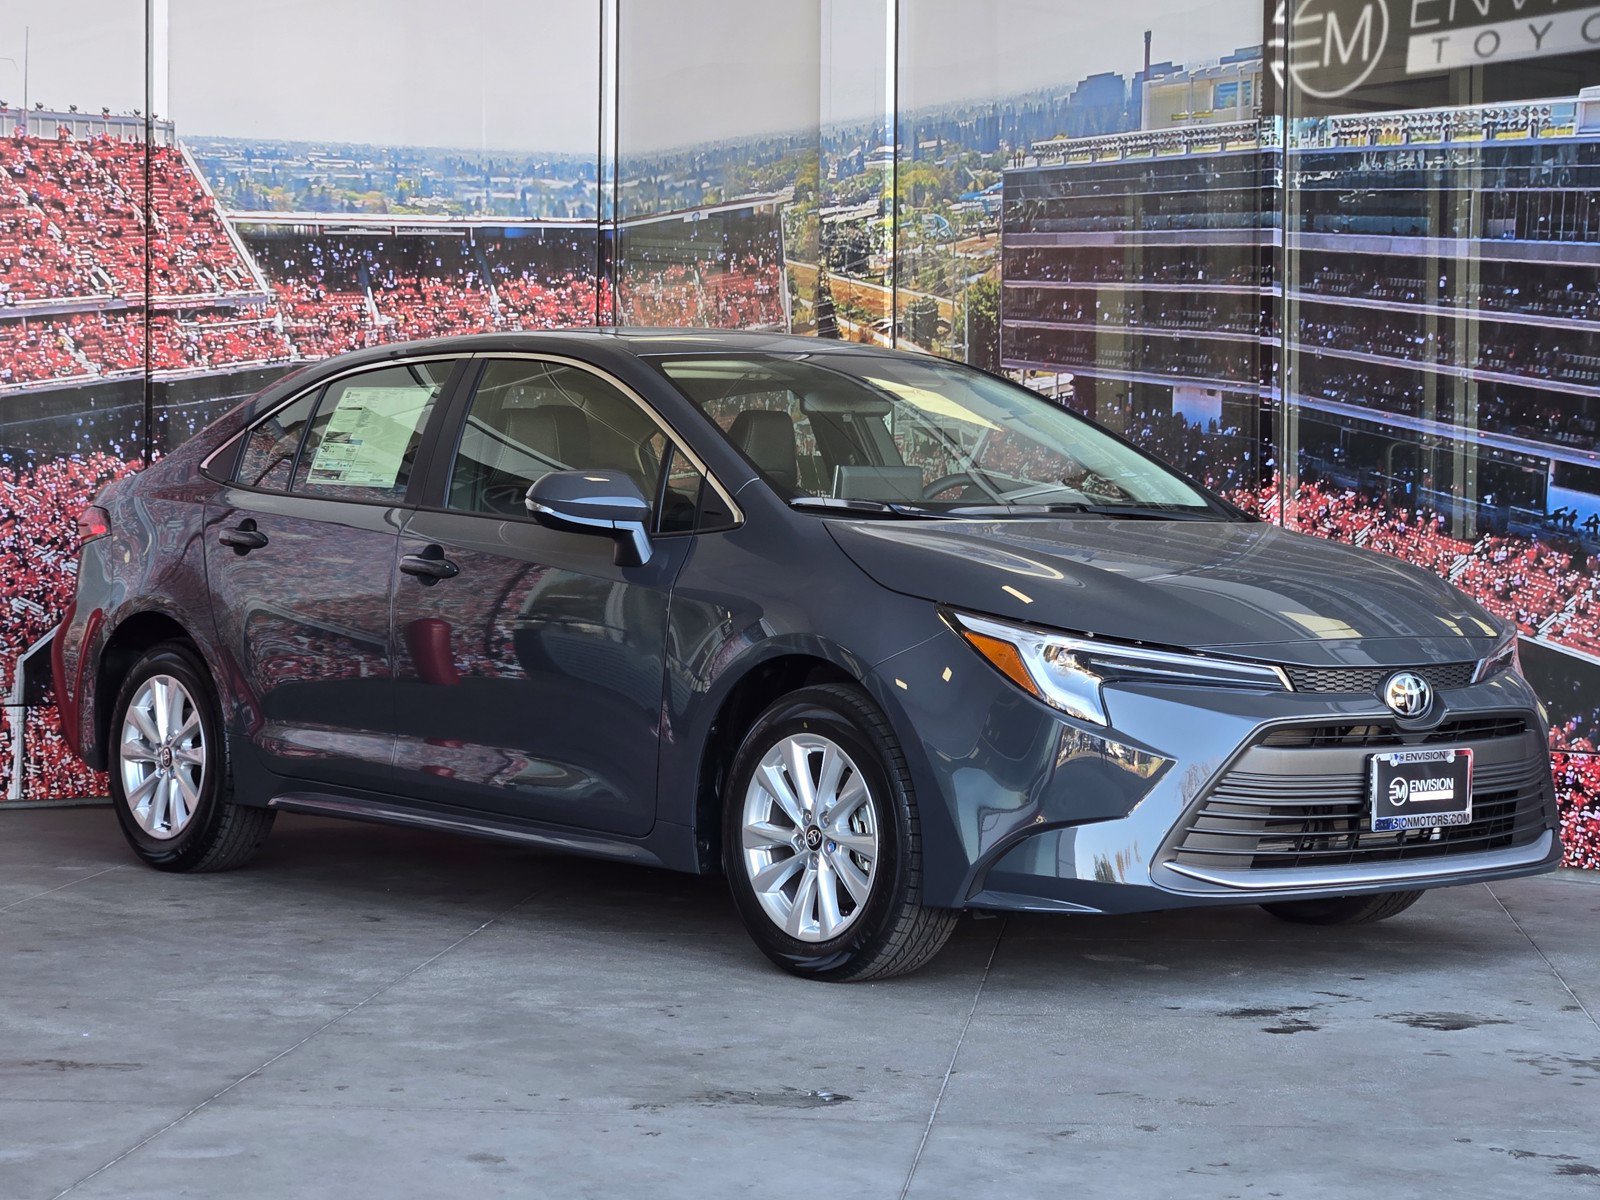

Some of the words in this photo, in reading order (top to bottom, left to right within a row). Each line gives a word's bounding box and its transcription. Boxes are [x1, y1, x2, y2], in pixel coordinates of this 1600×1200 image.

[1406, 751, 1446, 761] ENVISION
[1410, 778, 1454, 792] ENVISION
[1375, 813, 1470, 830] SIONMOTORS.COM
